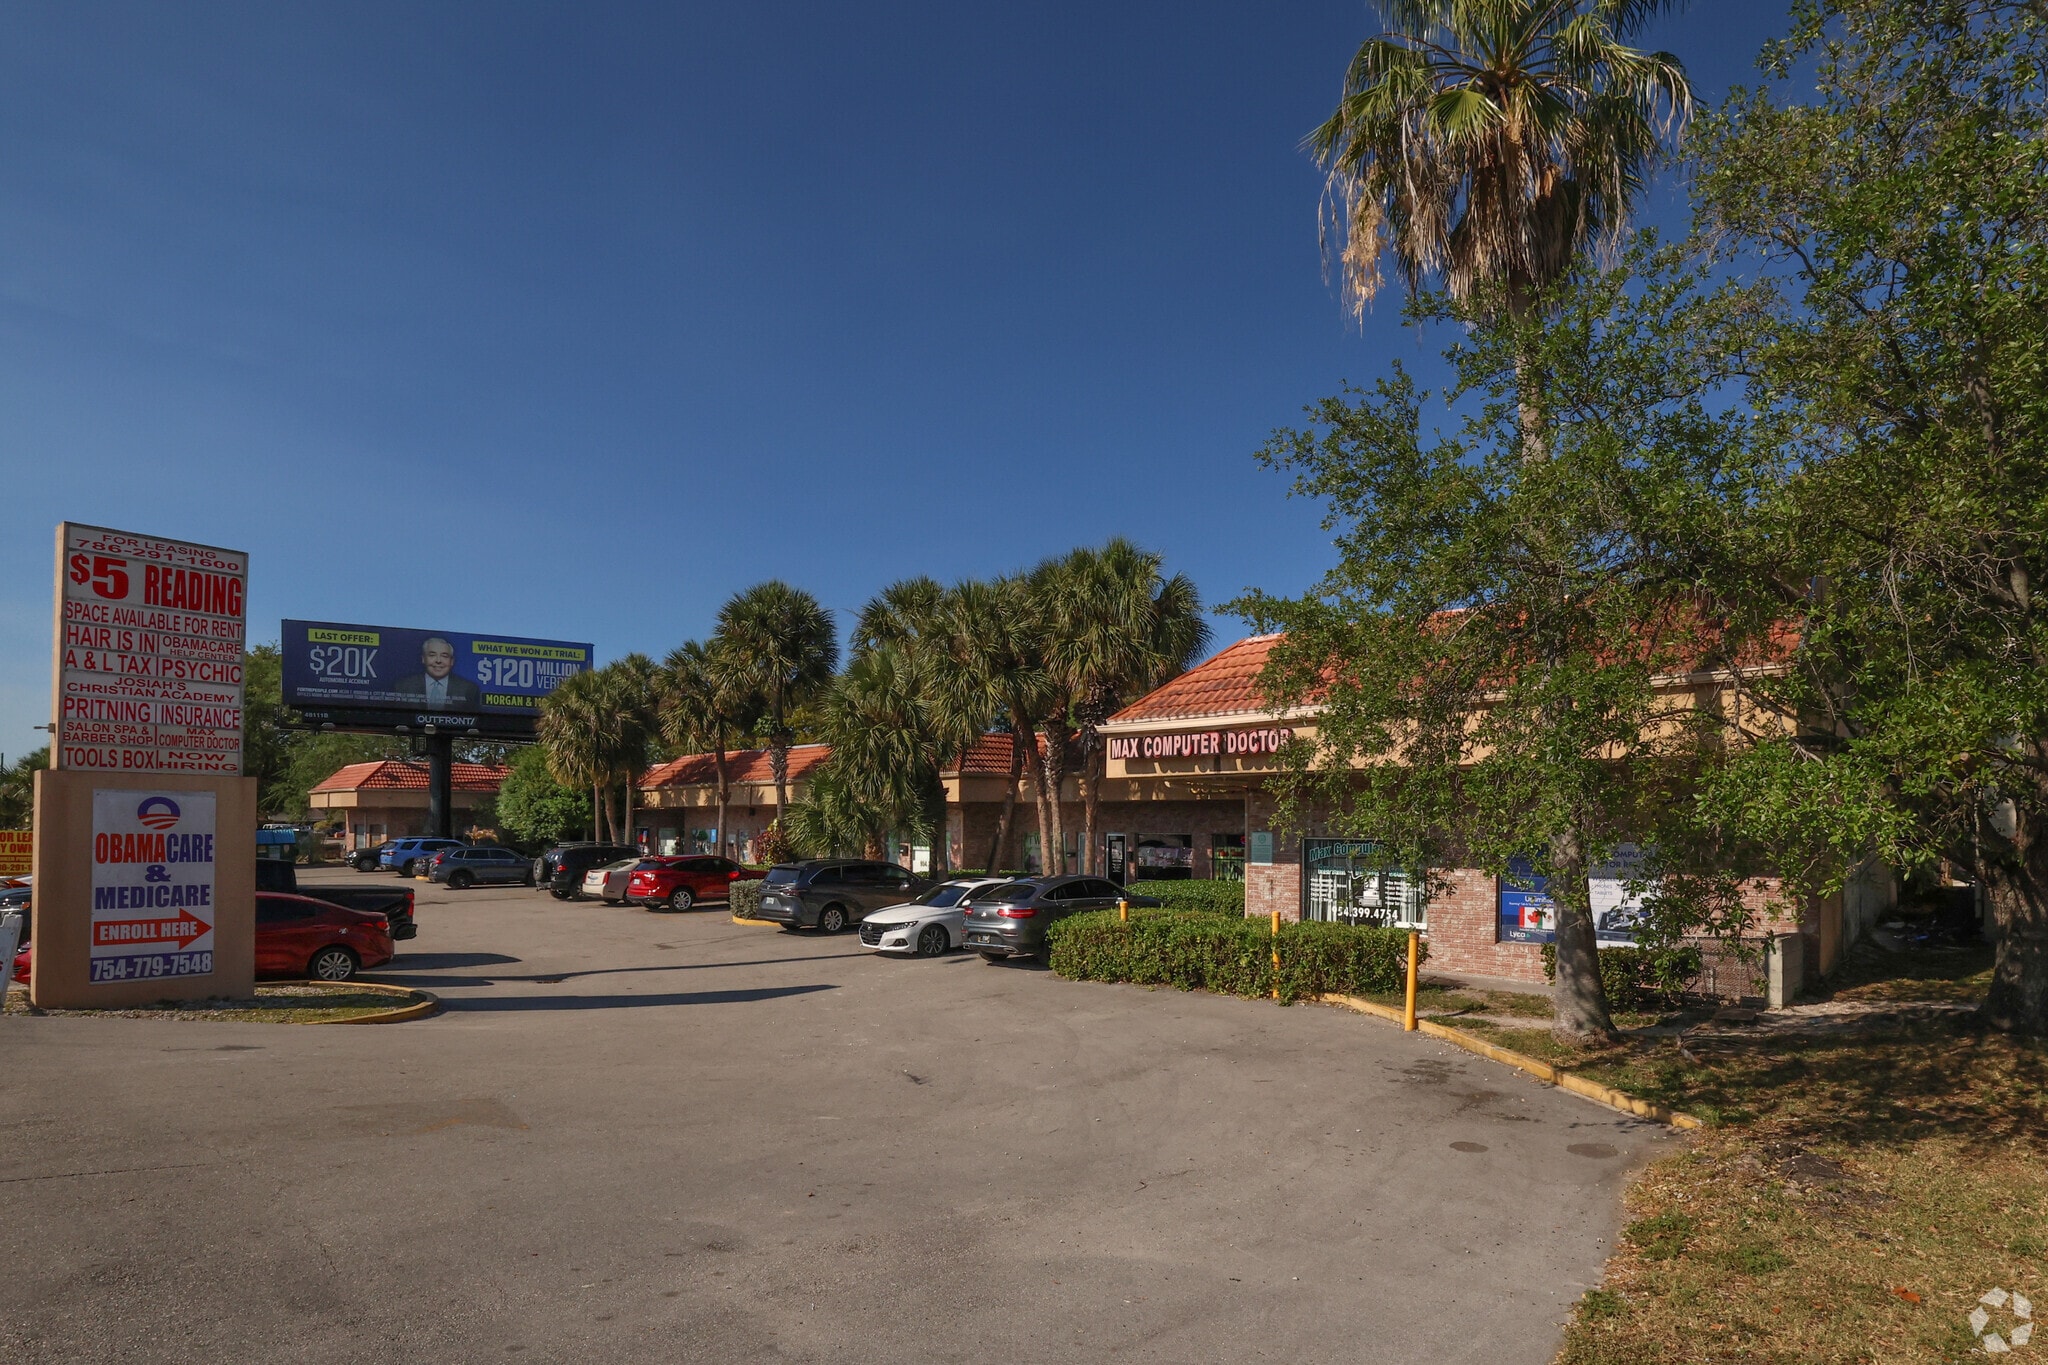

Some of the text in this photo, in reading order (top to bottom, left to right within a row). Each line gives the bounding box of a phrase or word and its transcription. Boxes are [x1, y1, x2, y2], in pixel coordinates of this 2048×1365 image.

[75, 538, 240, 571] 786-291-1600
[102, 534, 216, 560] FOR LEASING
[69, 553, 242, 617] $5 READING
[66, 602, 242, 639] SPACE AVAILABLE FOR RENT
[67, 624, 154, 654] HAIR IS IN
[162, 635, 242, 655] OBAMACARE
[314, 632, 374, 643] LAST OFFER:
[170, 648, 235, 662] HELP CENTER
[310, 645, 378, 678] $20K
[478, 644, 503, 653] WHAT
[505, 646, 518, 654] WE
[519, 647, 540, 656] WON
[554, 650, 581, 659] TRIAL:
[65, 650, 152, 676] A & L TAX
[162, 658, 242, 684] PSYCHIC
[477, 657, 581, 688] $120 MILLION
[67, 682, 235, 703] CHRISTIAN ACADEMY
[114, 676, 186, 691] JOSIAH'S
[64, 696, 151, 723] PRITNING
[485, 694, 524, 706] MORGAN
[525, 696, 533, 706] &
[161, 704, 240, 730] INSURANCE
[63, 732, 153, 745] BARBER SHOP
[66, 722, 150, 735] SALON SPA &
[186, 728, 216, 736] MAX
[159, 734, 240, 750] COMPUTER DOCTOR
[1110, 736, 1139, 760] MAX
[1143, 731, 1220, 758] COMPUTER
[64, 747, 156, 769] TOOLS BOX
[158, 761, 238, 771] HIRING
[168, 752, 226, 761] NOW
[0, 832, 33, 842] OR LEA
[95, 833, 213, 864] OBAMACARE
[1309, 845, 1332, 862] Max
[144, 864, 172, 883] &
[94, 884, 210, 910] MEDICARE
[1331, 906, 1398, 920] 954.399.4754
[100, 921, 198, 941] ENROLL HERE
[92, 952, 213, 981] 754-779-7548
